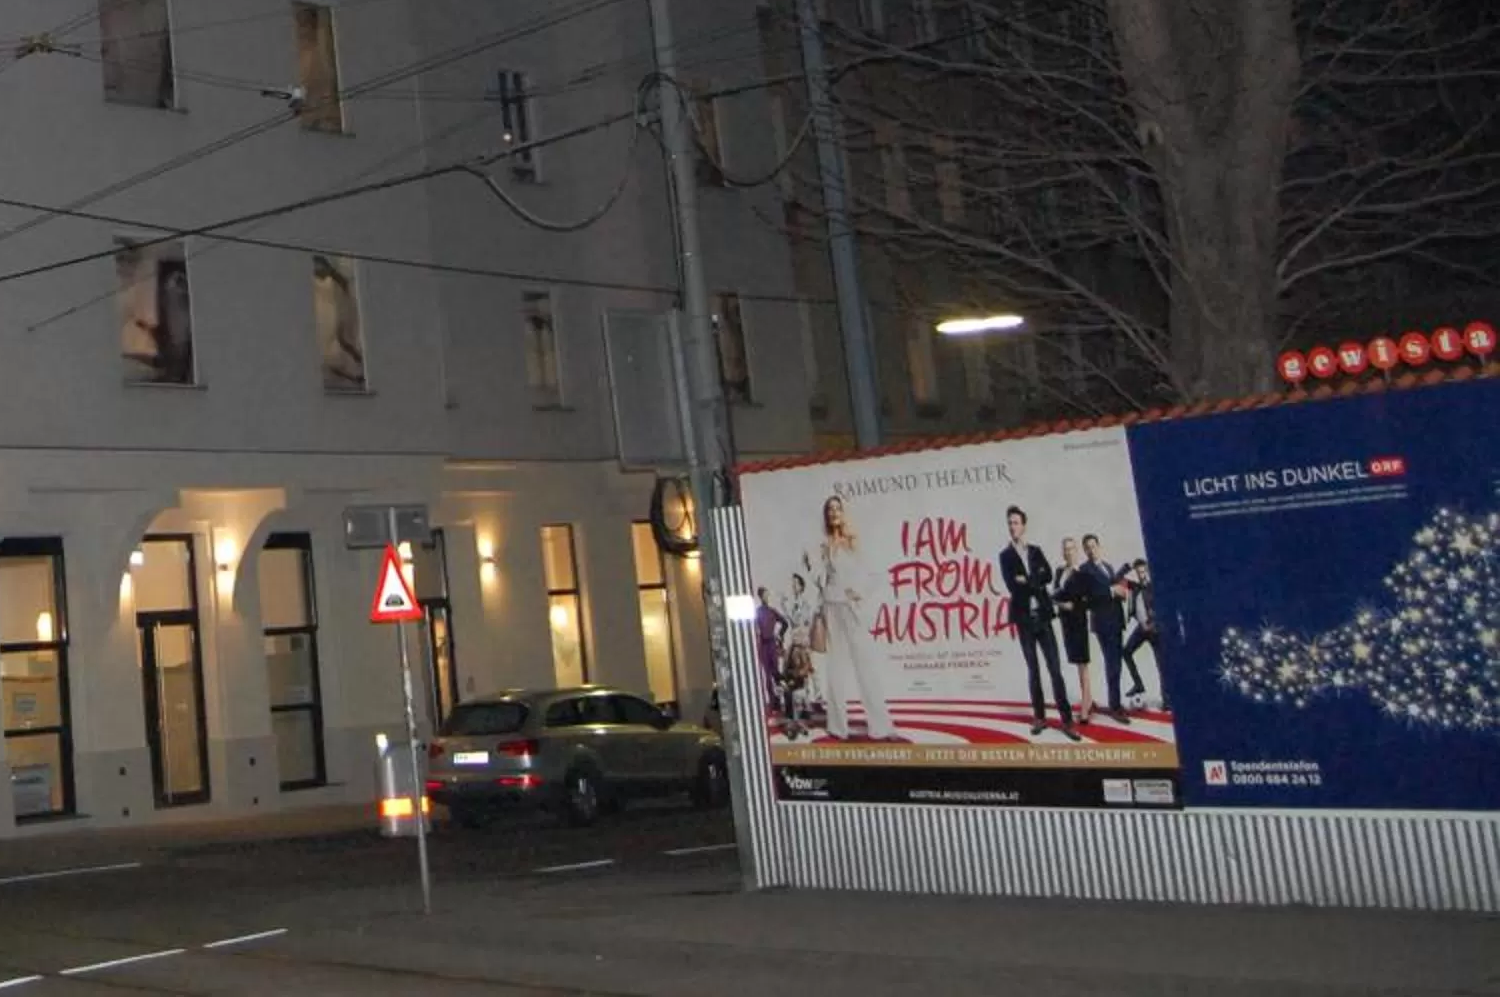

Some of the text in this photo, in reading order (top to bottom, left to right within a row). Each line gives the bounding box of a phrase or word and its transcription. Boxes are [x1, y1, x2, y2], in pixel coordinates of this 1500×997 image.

[1284, 330, 1489, 376] gewista
[833, 464, 1014, 500] RAIMUND THEATER
[1184, 461, 1368, 497] LICHT INS DUNKEL
[1371, 459, 1403, 475] ORF
[901, 517, 971, 565] I AM
[888, 555, 1000, 600] FROM
[868, 598, 1016, 645] AUSTRIA
